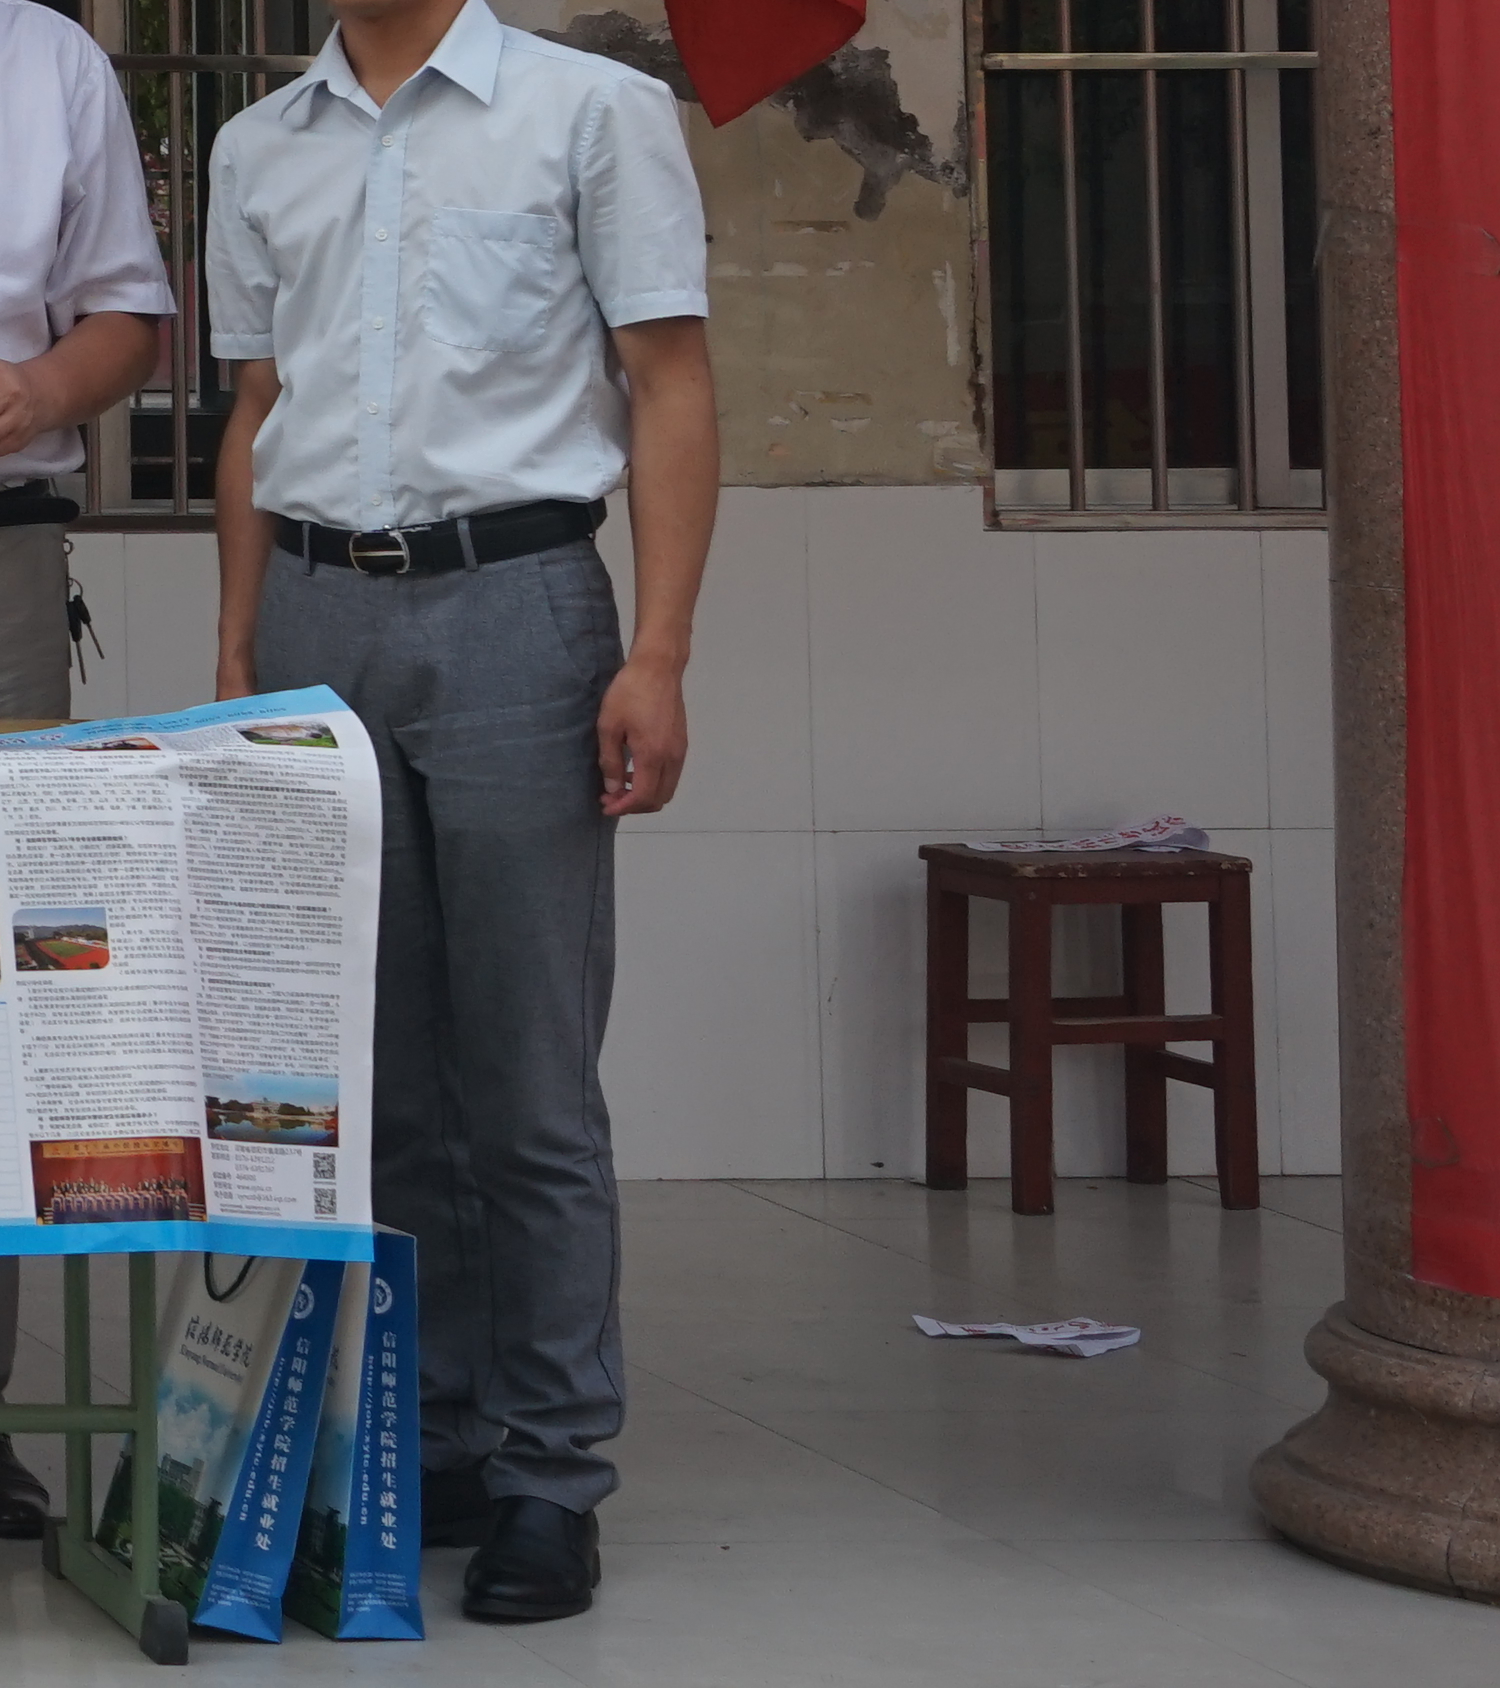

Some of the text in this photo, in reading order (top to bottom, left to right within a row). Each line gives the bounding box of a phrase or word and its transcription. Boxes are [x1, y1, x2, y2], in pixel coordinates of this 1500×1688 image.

[254, 1335, 311, 1552] 信阳师范学院招生就业处
[378, 1329, 399, 1550] 信阳师范学院招生就业处
